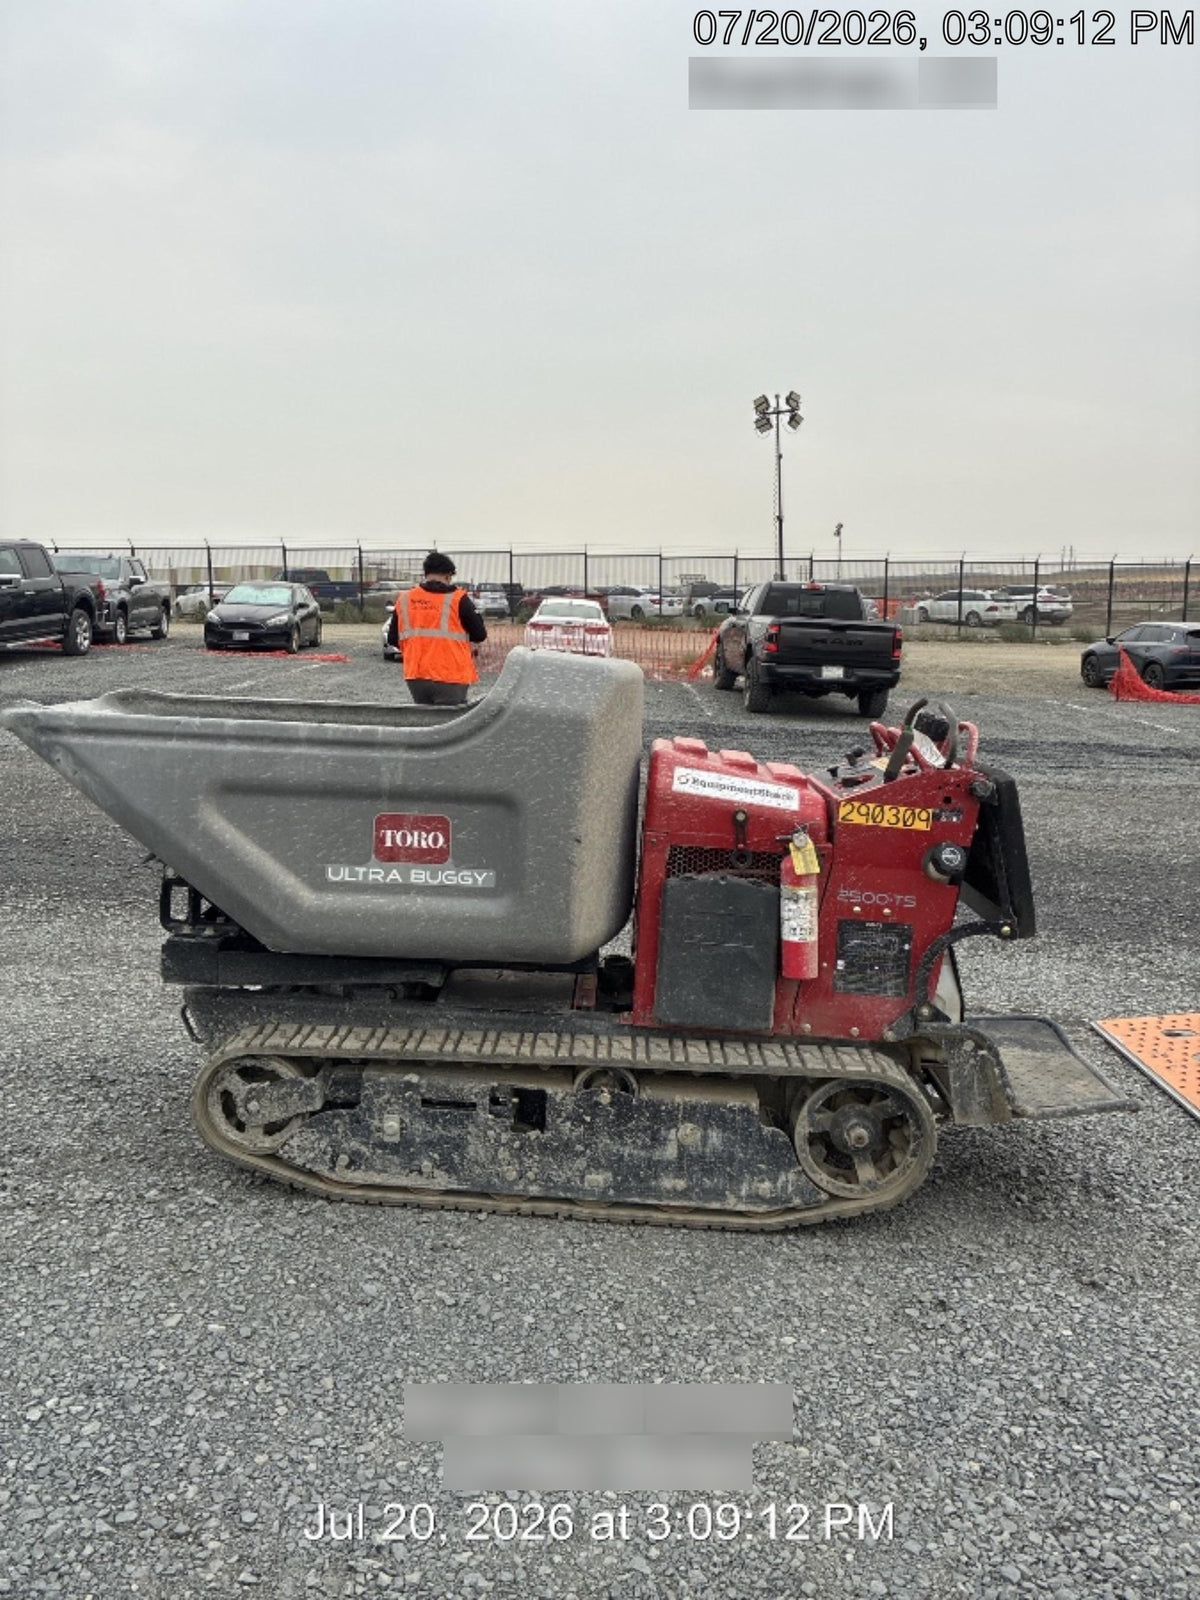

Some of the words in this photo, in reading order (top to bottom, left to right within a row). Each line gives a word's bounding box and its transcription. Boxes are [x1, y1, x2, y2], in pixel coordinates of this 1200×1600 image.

[840, 801, 931, 829] 290309
[380, 829, 445, 849] TORO
[327, 866, 403, 883] ULTRA
[409, 869, 488, 885] BUGGY
